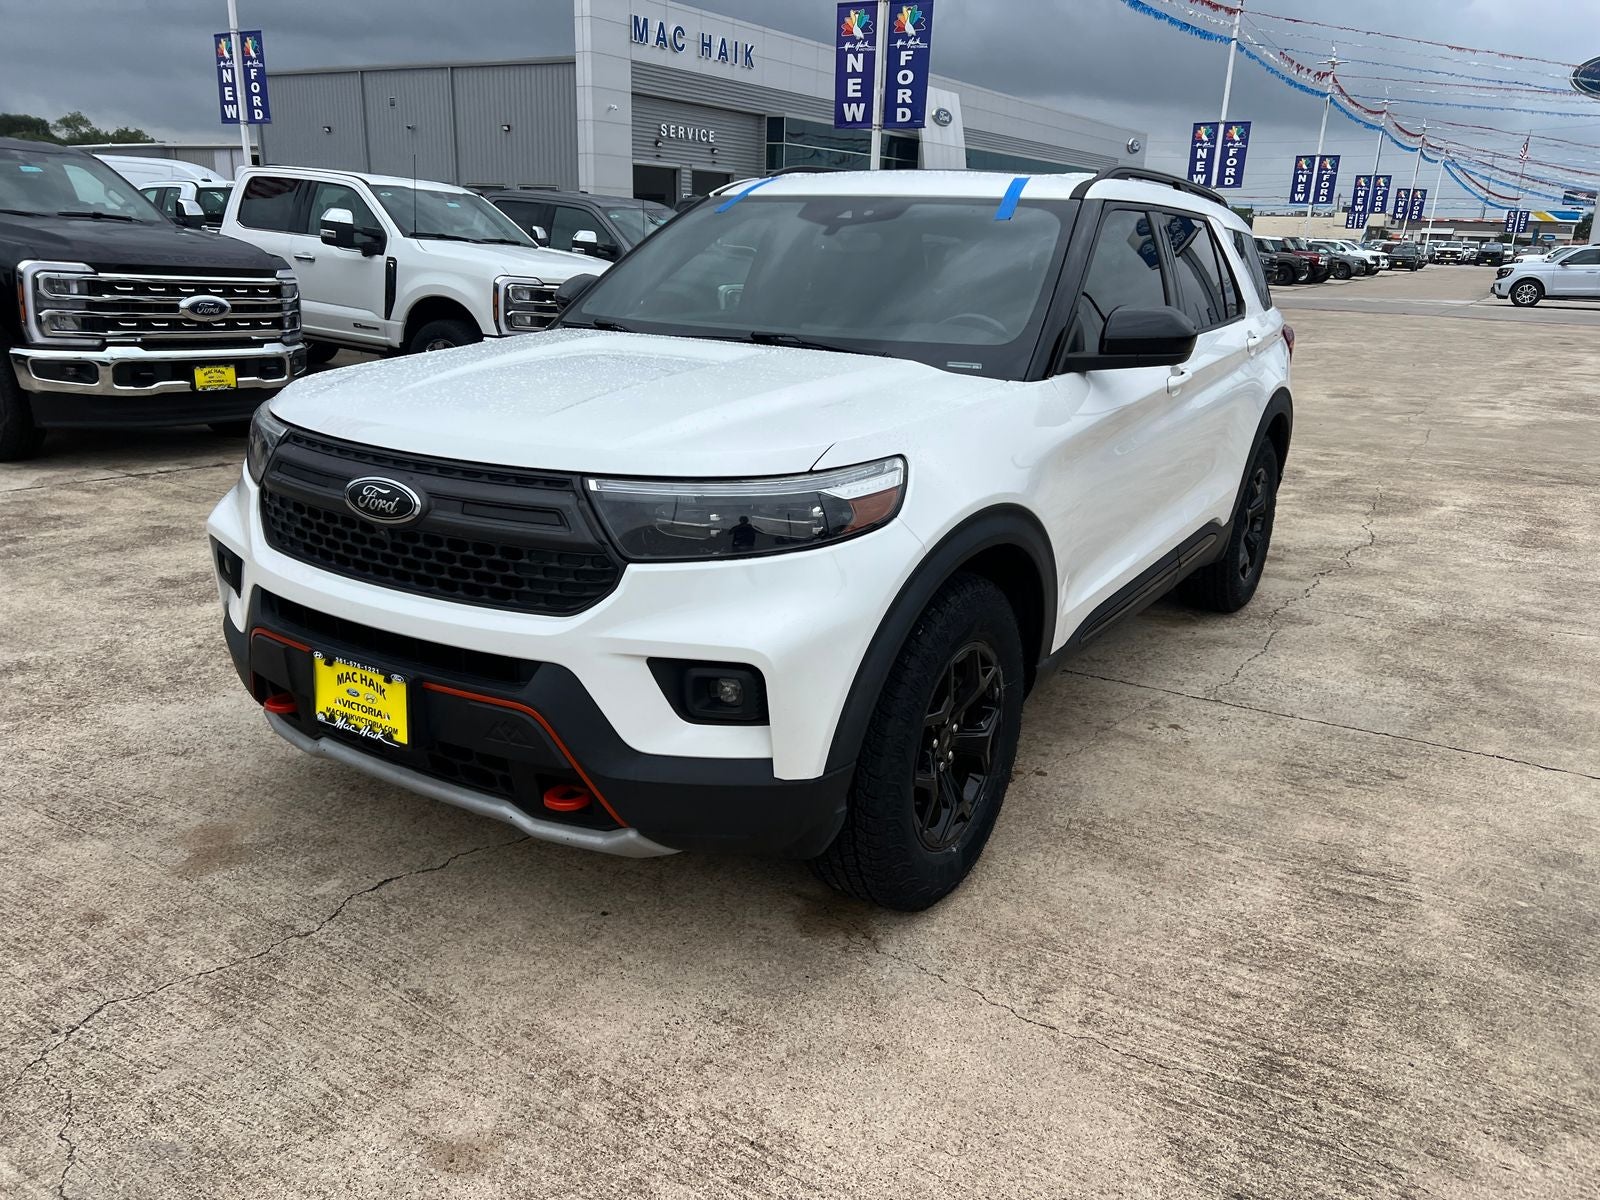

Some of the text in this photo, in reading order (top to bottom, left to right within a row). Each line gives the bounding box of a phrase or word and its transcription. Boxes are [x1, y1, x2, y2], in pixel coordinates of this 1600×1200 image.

[631, 14, 755, 69] MAC HAIK
[222, 68, 238, 119] NEW
[250, 68, 264, 120] FORD
[842, 53, 866, 122] NEW
[896, 50, 914, 123] FORD
[660, 123, 715, 143] SERVICE
[1192, 148, 1208, 185] NEW
[1224, 148, 1239, 186] FORD
[1294, 174, 1307, 202] NEW
[1318, 174, 1331, 202] FORD
[1354, 190, 1366, 212] NEW
[1374, 190, 1384, 212] FORD
[1395, 201, 1405, 219] NEW
[1411, 201, 1420, 220] FORD
[197, 302, 220, 314] Ford
[357, 485, 400, 514] Ford
[337, 671, 358, 687] MAC
[359, 673, 387, 701] HAIK
[326, 706, 399, 735] MACHAIKVICTORIA.COM
[341, 697, 383, 719] VICTORIA
[332, 716, 359, 732] Mac
